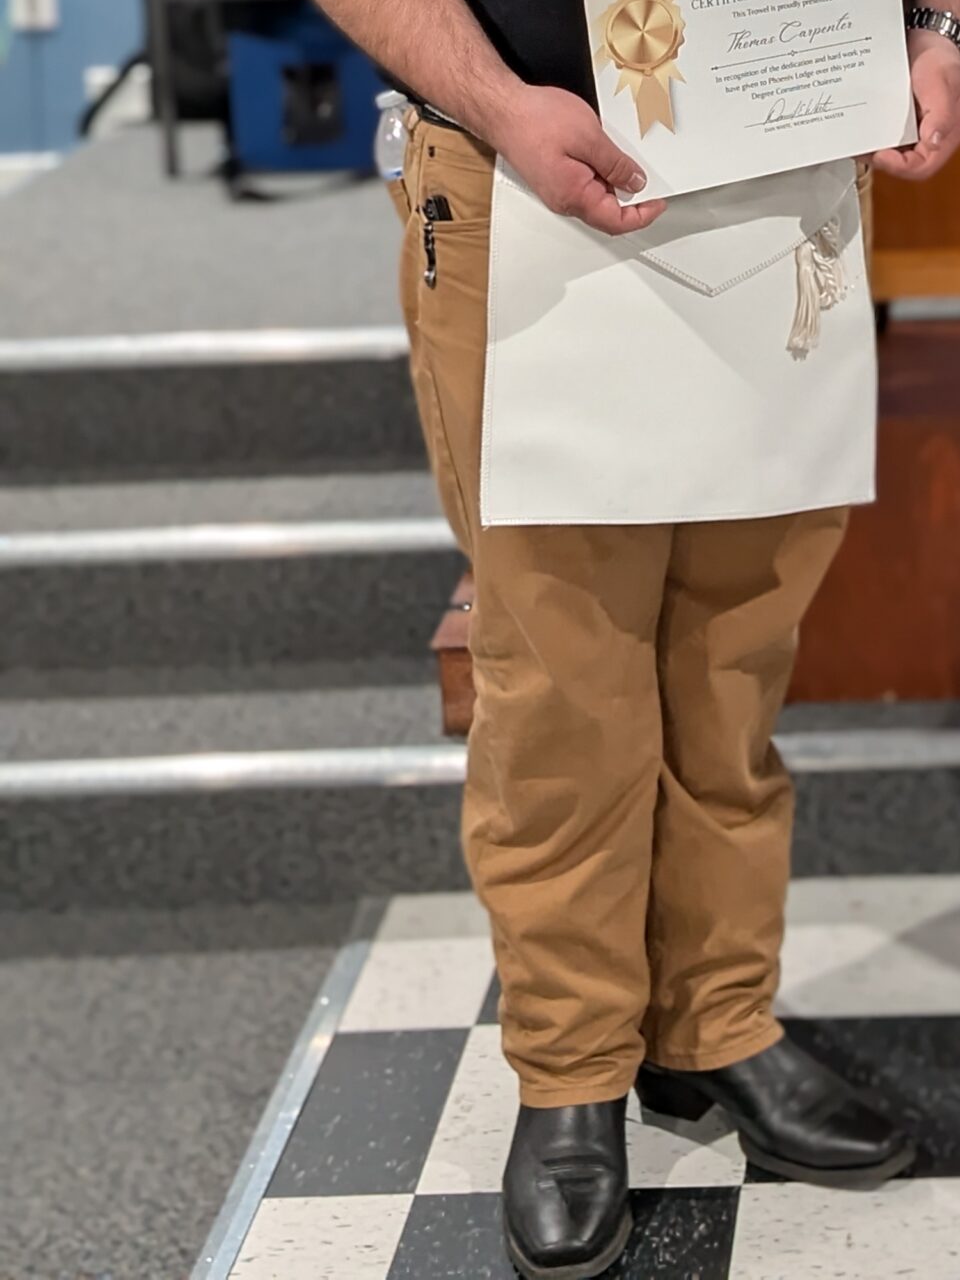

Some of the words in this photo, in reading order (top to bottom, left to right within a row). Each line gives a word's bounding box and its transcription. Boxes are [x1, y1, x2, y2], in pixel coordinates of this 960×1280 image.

[732, 10, 746, 19] This
[777, 1, 801, 13] proudly
[726, 29, 776, 53] Thomas
[779, 12, 853, 43] Carpenter
[715, 76, 723, 84] In
[724, 69, 760, 83] recognition
[760, 67, 768, 75] of
[769, 64, 781, 73] the
[781, 59, 814, 71] dedication
[814, 55, 827, 65] and
[827, 51, 842, 62] hard
[842, 49, 858, 60] work
[859, 48, 871, 58] you
[725, 85, 741, 94] have
[742, 81, 759, 93] given
[768, 74, 794, 86] Phoenix
[795, 69, 815, 82] Lodge
[815, 67, 829, 76] over
[830, 64, 843, 74] this
[843, 62, 857, 73] year
[857, 60, 865, 68] as
[751, 89, 775, 102] Degree
[775, 82, 811, 96] Committee
[812, 76, 843, 89] Chairman
